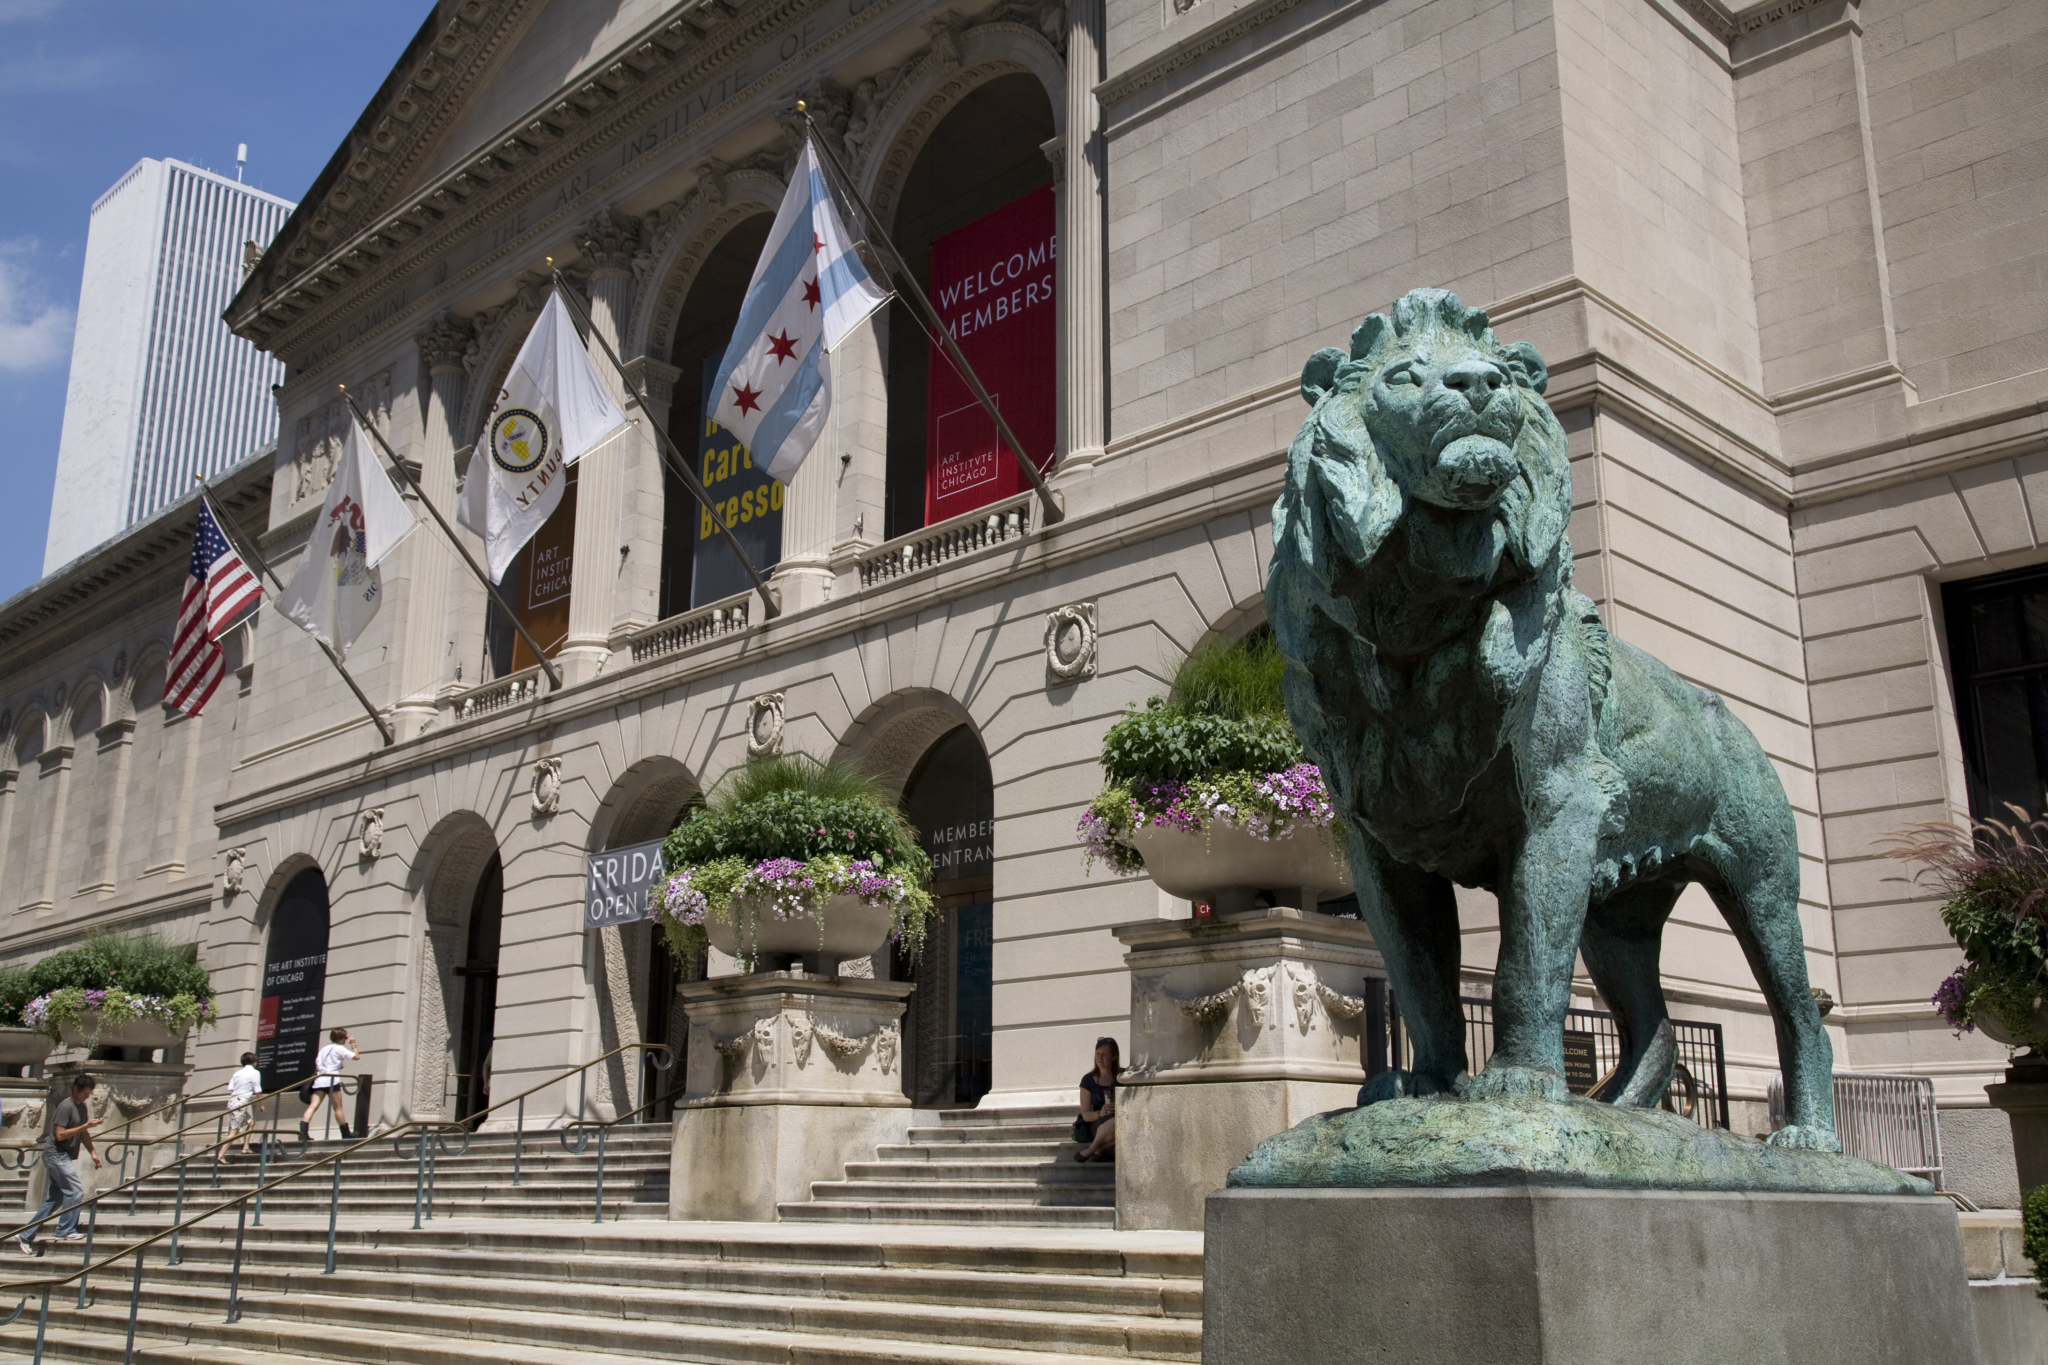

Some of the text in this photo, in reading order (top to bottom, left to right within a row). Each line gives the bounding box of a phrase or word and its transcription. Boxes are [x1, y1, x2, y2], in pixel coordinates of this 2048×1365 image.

[492, 19, 816, 249] THE ART INSTITVTE OF
[940, 234, 1056, 310] WELCOME
[302, 289, 406, 370] ANNO DOMINI
[941, 451, 960, 467] ART
[942, 451, 993, 478] INSTITVTE
[941, 466, 987, 490] CHICAGO
[537, 545, 559, 564] ART
[537, 556, 571, 580] INSTIT
[933, 819, 994, 845] MEMBER
[591, 891, 637, 920] OPEN
[268, 954, 326, 973] THE ART INSTITUTE
[266, 971, 304, 987] OF CHICAGO
